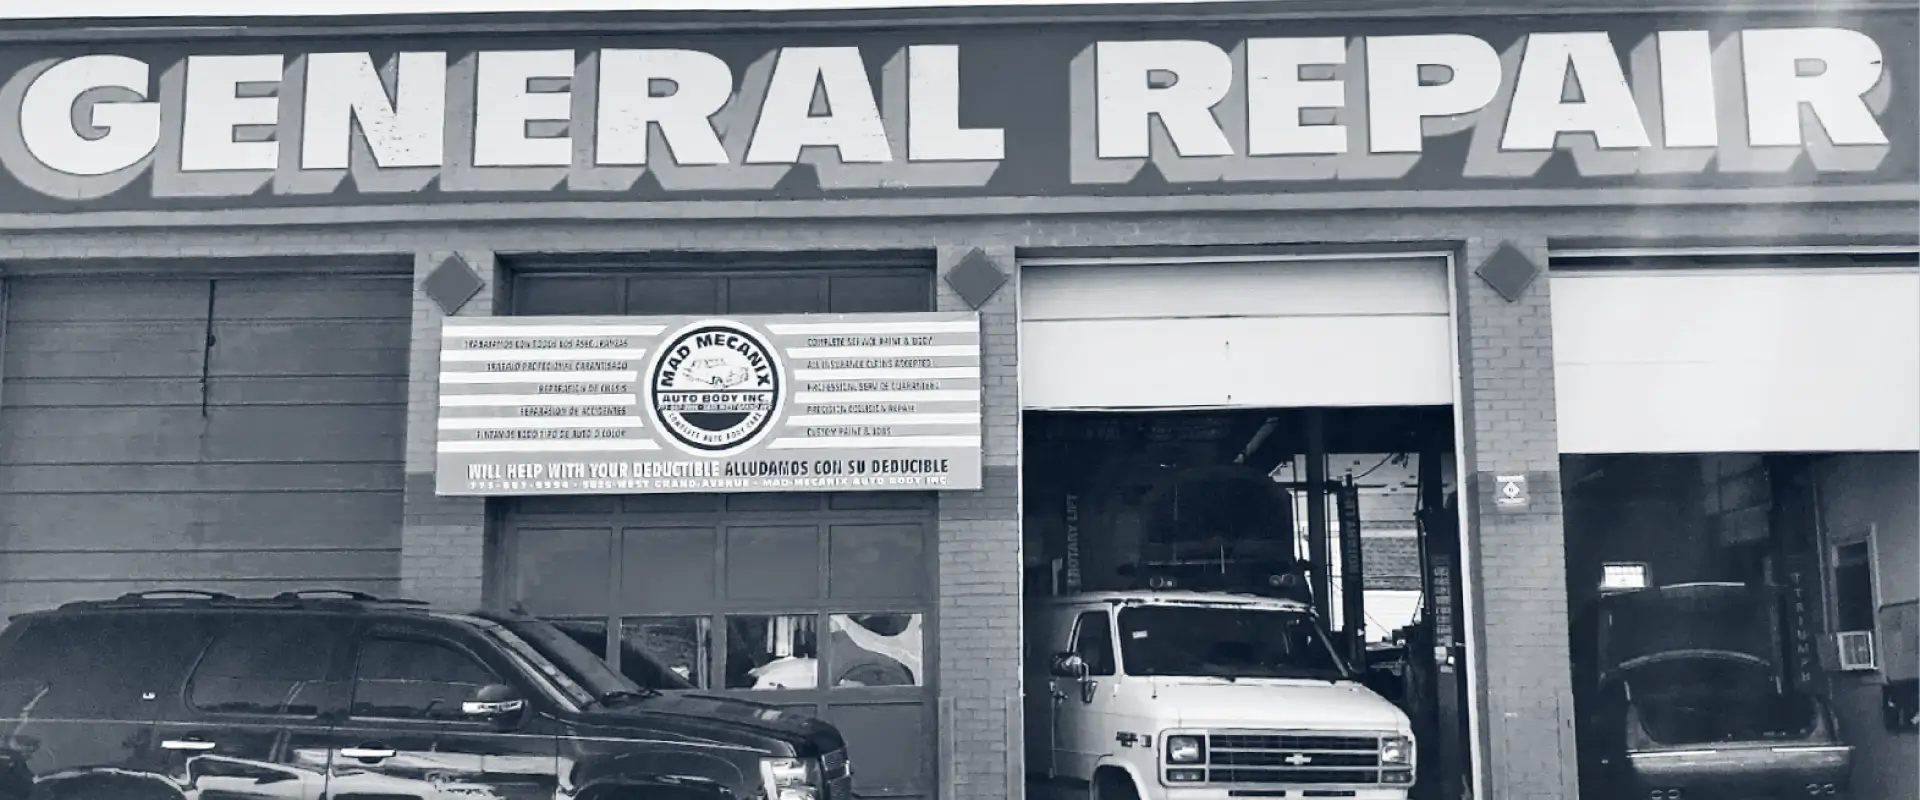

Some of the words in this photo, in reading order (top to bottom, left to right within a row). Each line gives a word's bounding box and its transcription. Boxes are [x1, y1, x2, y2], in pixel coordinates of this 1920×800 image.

[19, 44, 1005, 175] GENERAL
[1096, 27, 1889, 157] REPAIR
[660, 346, 690, 386] MAD
[696, 334, 770, 386] MECANIX
[662, 394, 698, 402] AUTO
[702, 394, 738, 402] BODY
[468, 463, 501, 480] WILL
[507, 462, 543, 479] HELP
[549, 462, 585, 478] WITH
[588, 461, 629, 478] YOUR
[633, 460, 720, 478] DEDUCTIBLE
[725, 460, 808, 476] ALLUDAMOS
[814, 460, 842, 475] CON
[848, 460, 865, 474] SU
[872, 458, 948, 473] DEDUCIBLE
[852, 477, 884, 486] AUTO
[1067, 494, 1078, 521] LIFT
